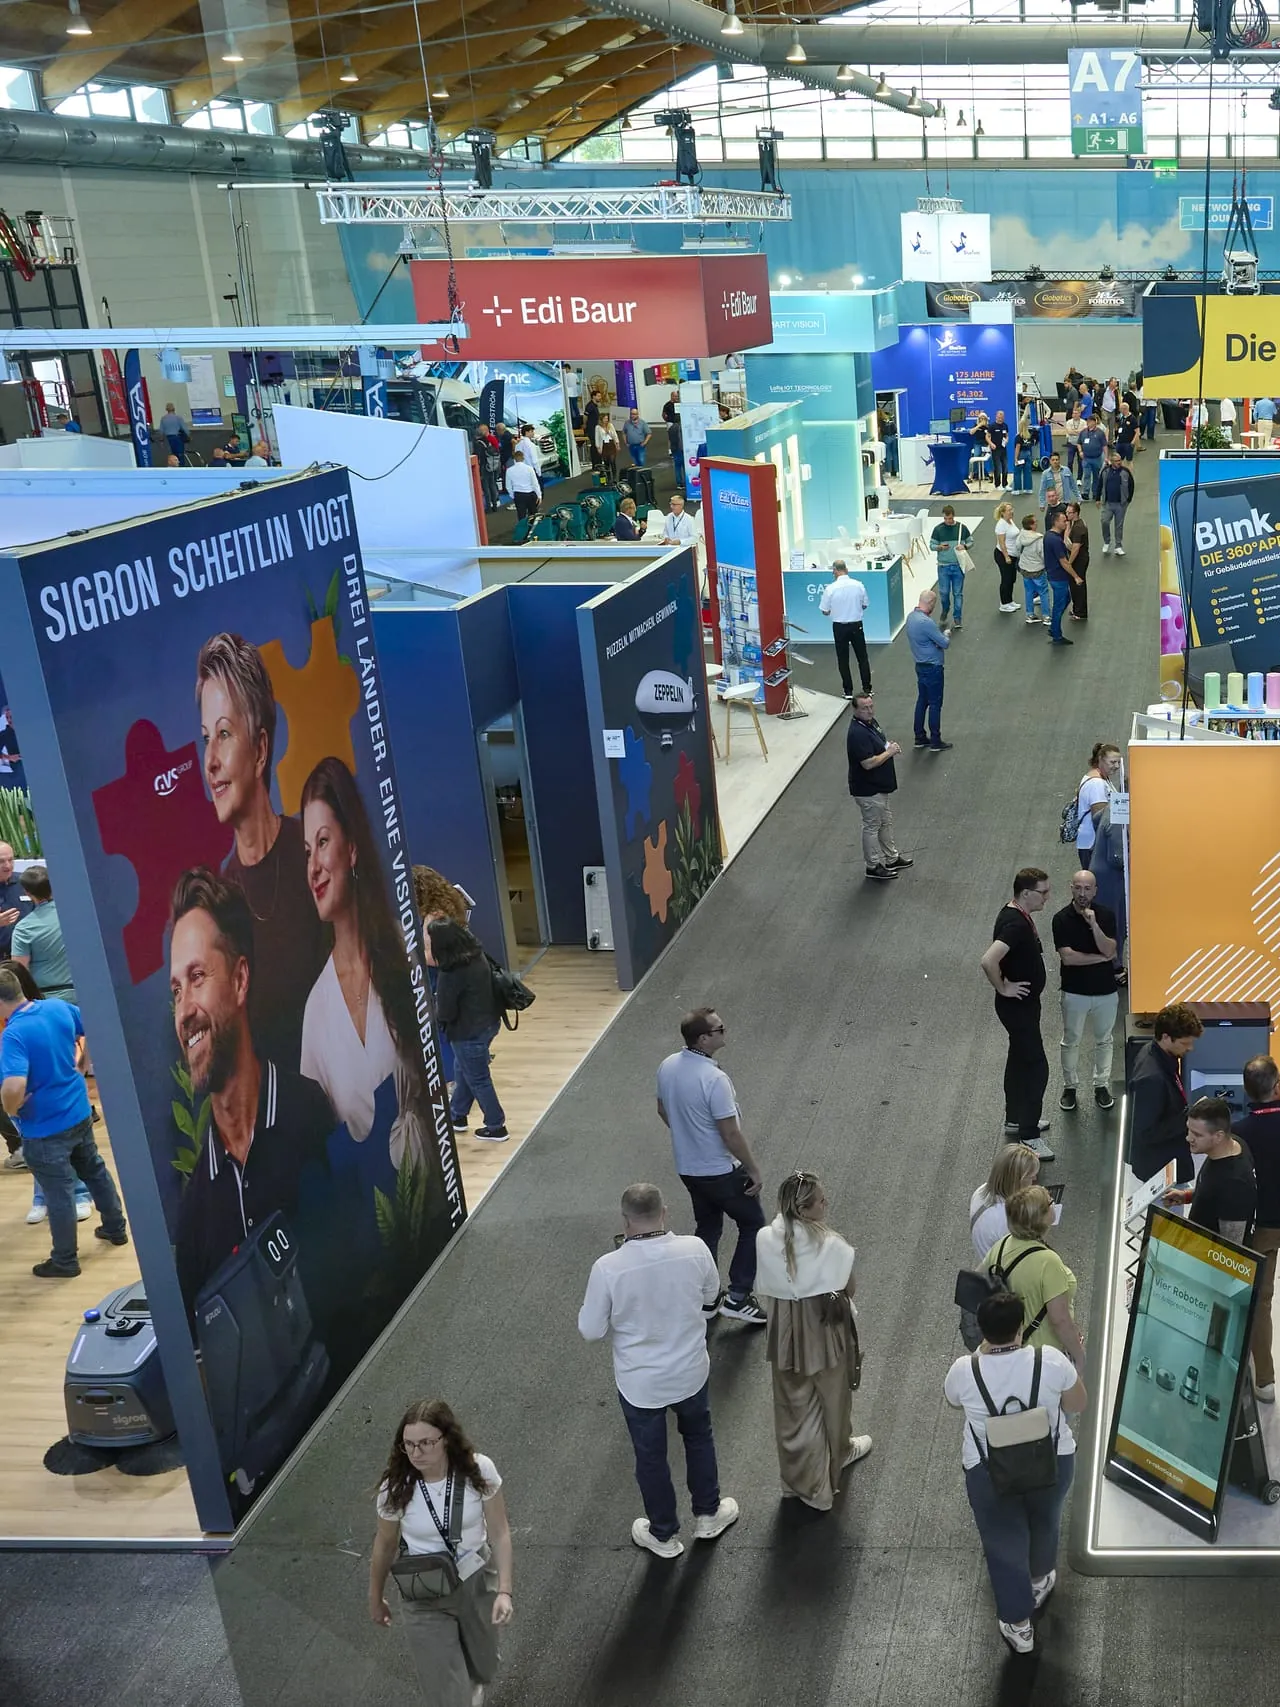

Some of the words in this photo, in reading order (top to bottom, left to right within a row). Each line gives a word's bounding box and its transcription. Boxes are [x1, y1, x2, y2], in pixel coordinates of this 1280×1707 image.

[1072, 52, 1137, 92] A7
[1089, 113, 1107, 124] A1
[1119, 113, 1137, 124] A6
[1134, 160, 1151, 169] A7
[521, 298, 563, 325] Edi
[570, 296, 637, 324] Baur
[730, 290, 742, 318] Edi
[742, 291, 757, 316] Baur
[1226, 332, 1276, 362] Die
[129, 382, 148, 445] QSA
[40, 555, 161, 643] SIGRON
[169, 514, 294, 599] SCHEITLIN
[299, 494, 350, 560] VOGT
[1200, 550, 1224, 567] DIE
[1204, 567, 1215, 578] für
[654, 684, 684, 703] ZEPPELIN
[342, 554, 366, 627] DREI
[356, 636, 387, 772] LÄNDER.
[379, 777, 401, 848] EINE
[392, 850, 417, 962] VISION.
[410, 964, 440, 1097] SAUBERE
[431, 1097, 467, 1228] ZUKUNFT.
[1208, 1249, 1252, 1277] robovox
[1155, 1278, 1171, 1290] Vier
[1173, 1286, 1210, 1313] Roboter.
[112, 1413, 147, 1426] sigron
